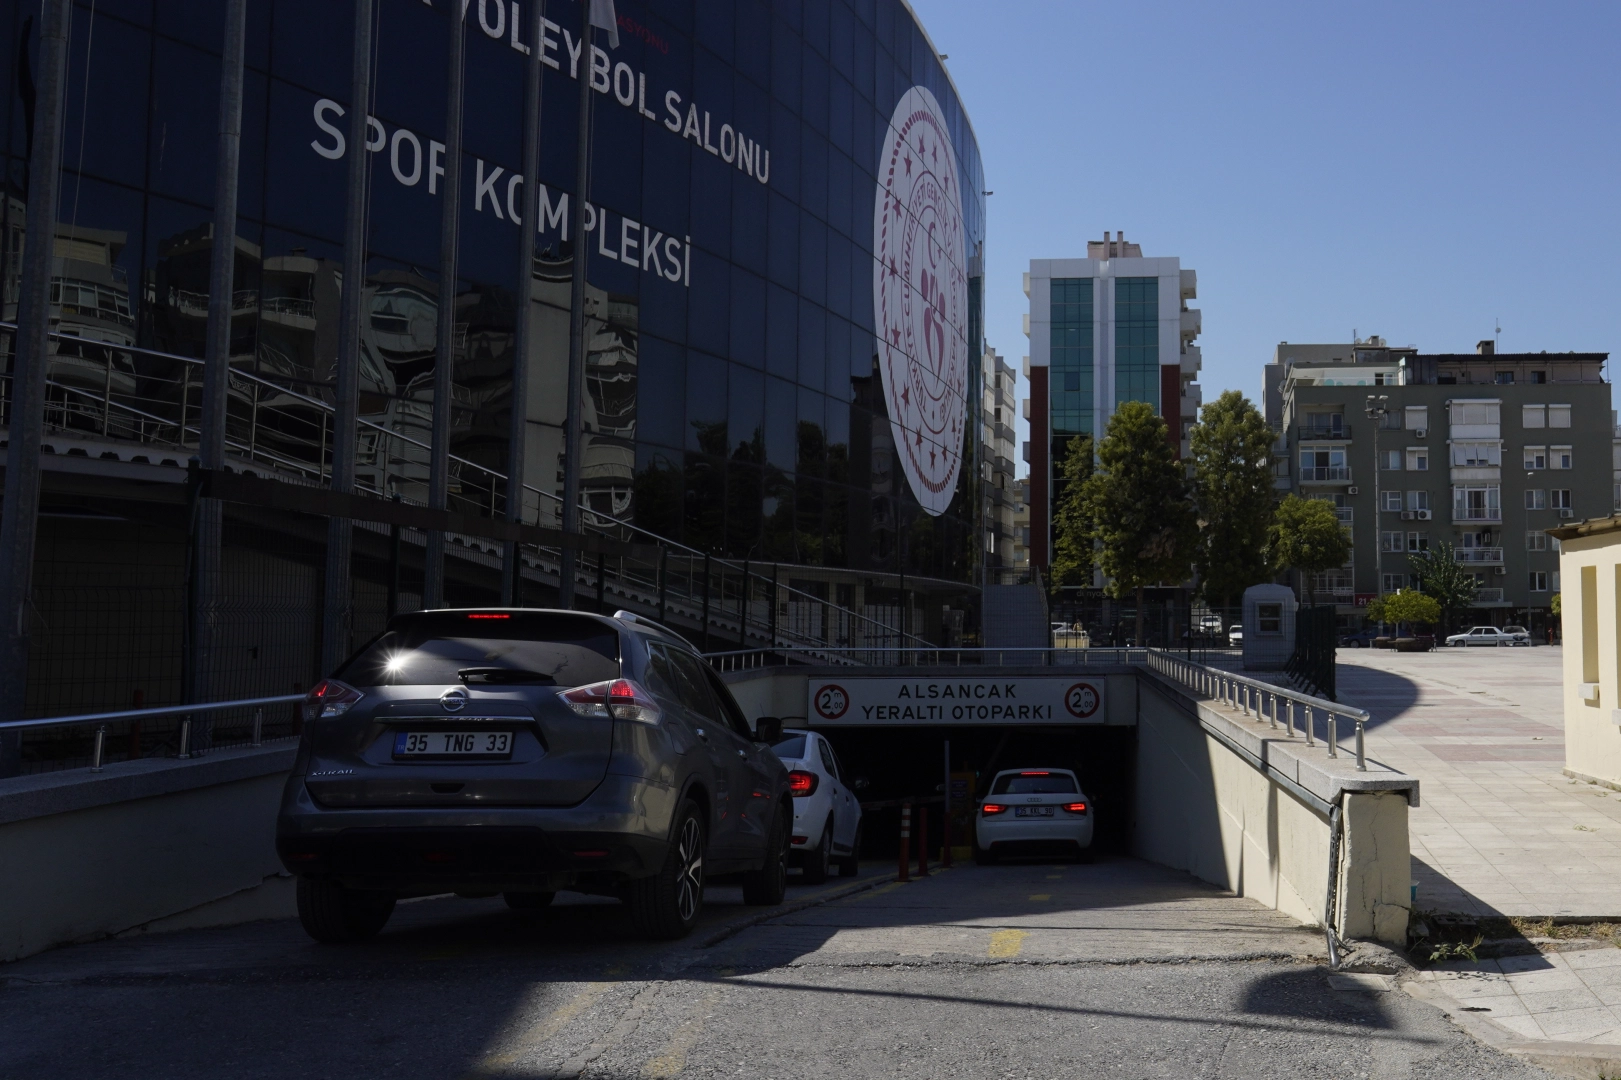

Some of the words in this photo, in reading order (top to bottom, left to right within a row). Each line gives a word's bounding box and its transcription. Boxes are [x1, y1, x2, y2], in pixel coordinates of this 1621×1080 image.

[616, 14, 670, 55] ASYONU
[461, 0, 656, 121] OLEYBOL
[664, 90, 770, 184] SALONU
[898, 684, 1017, 699] ALSANCAK
[861, 705, 943, 720] YERALTI
[952, 704, 1052, 720] OTOPARKI
[407, 735, 428, 752] 35
[444, 734, 475, 752] TNG
[486, 734, 508, 752] 33
